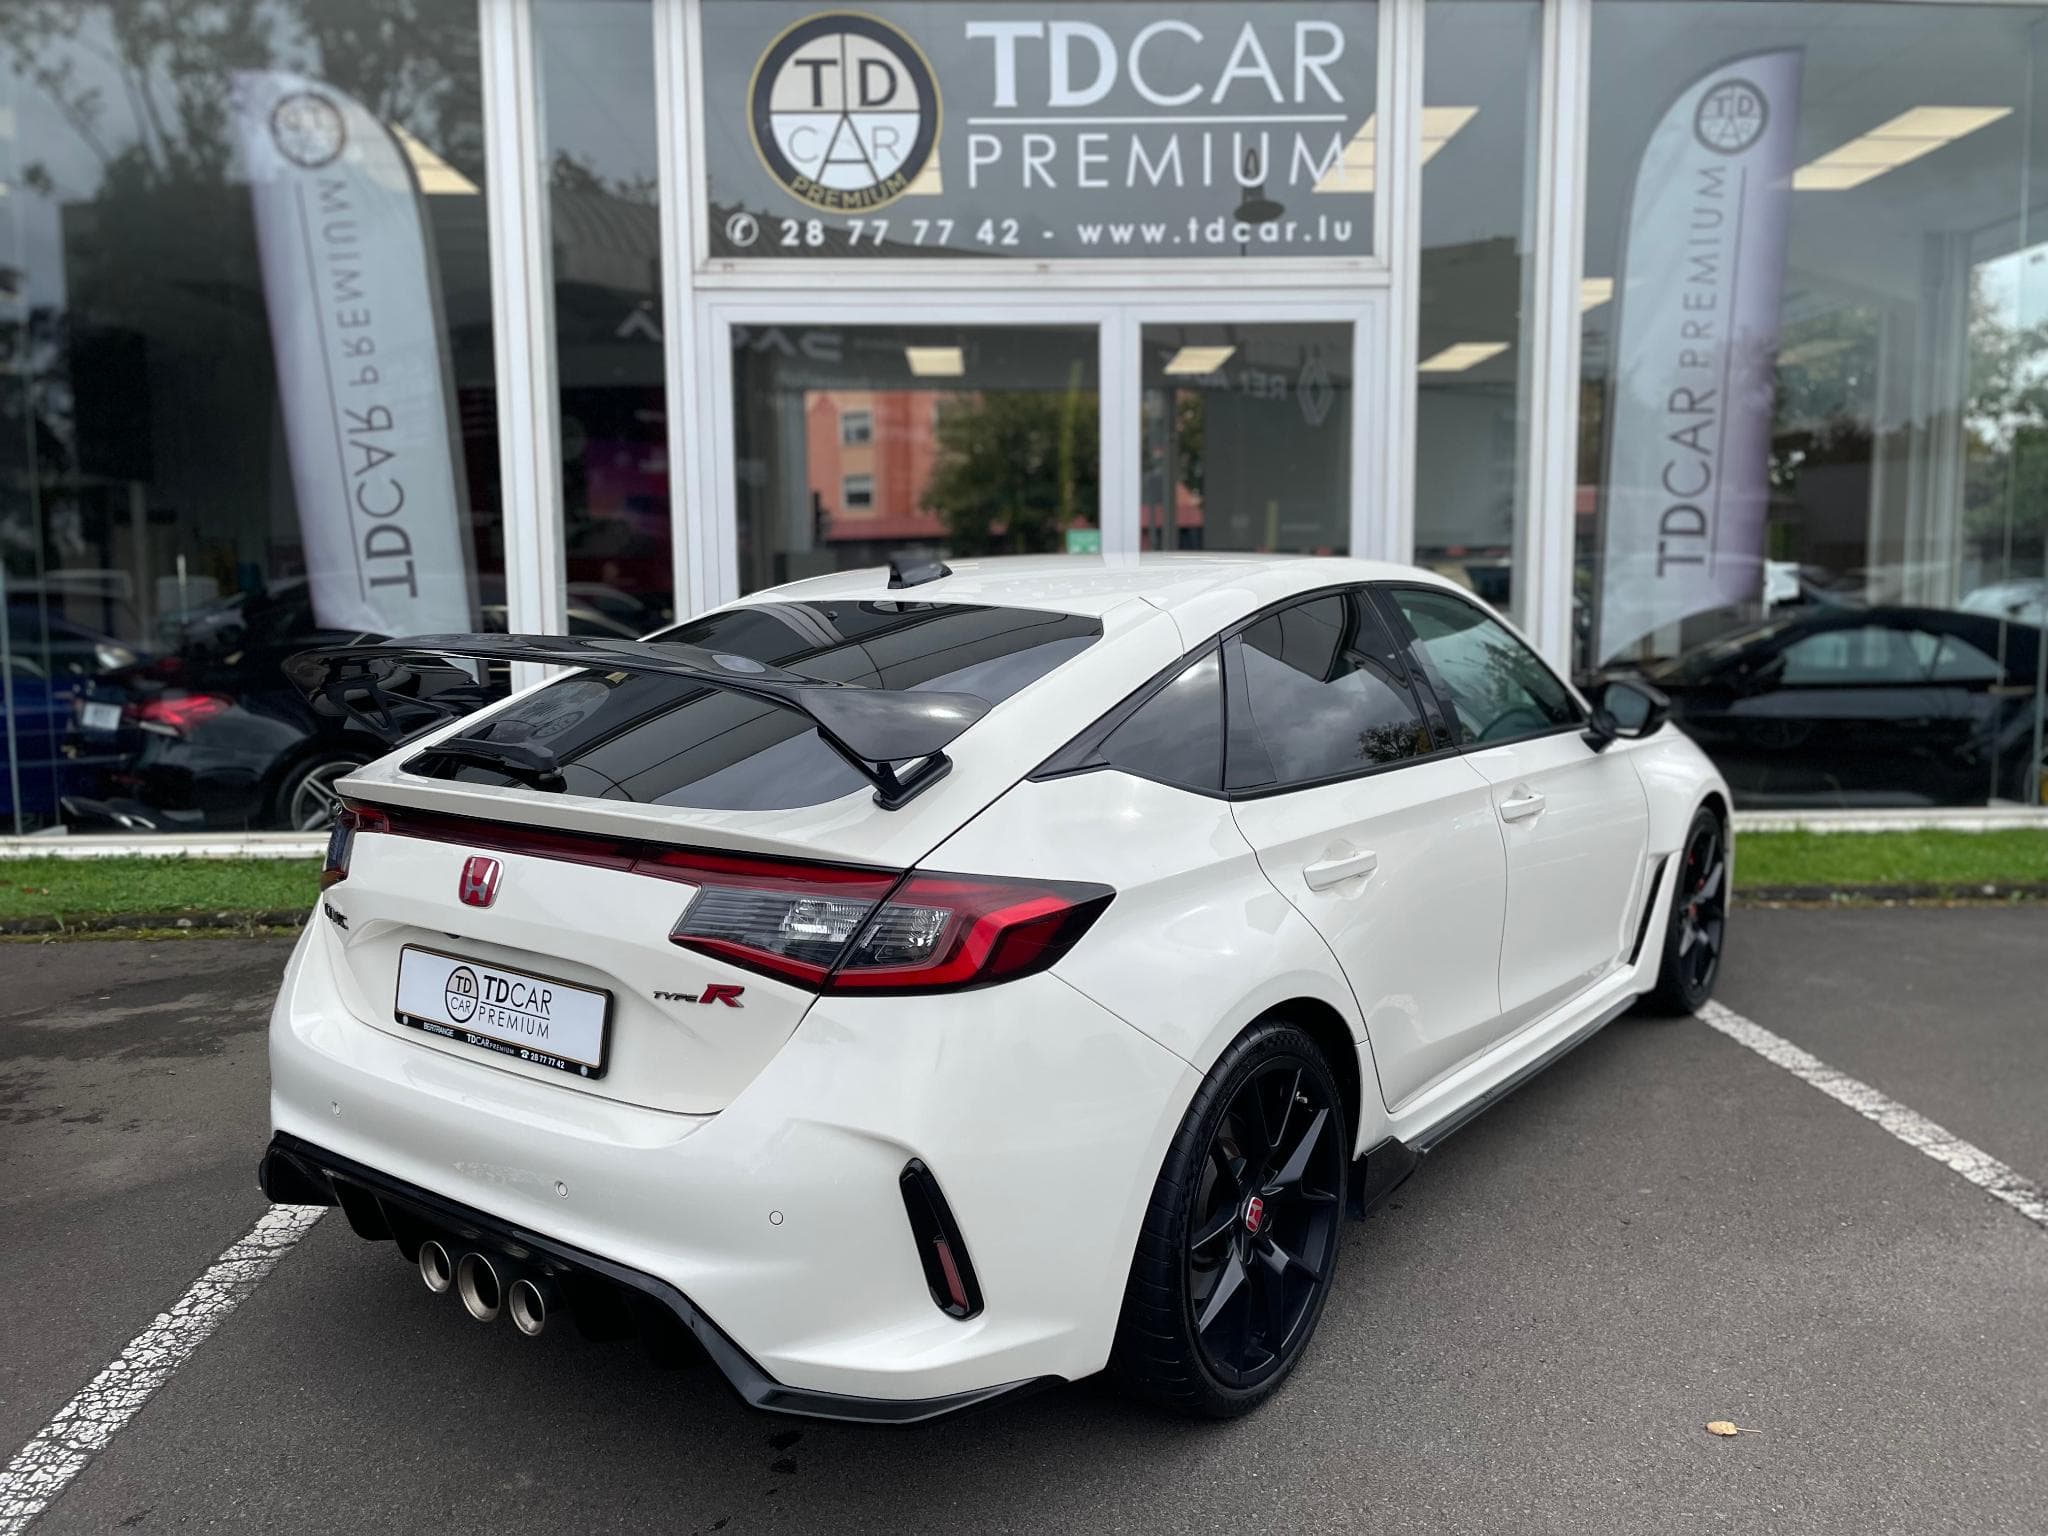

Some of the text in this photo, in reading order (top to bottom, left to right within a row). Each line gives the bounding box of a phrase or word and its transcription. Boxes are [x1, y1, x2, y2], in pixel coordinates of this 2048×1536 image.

[966, 20, 1346, 107] TDCAR
[968, 132, 1346, 188] PREMIUM
[788, 173, 908, 210] PREMIUM
[780, 219, 826, 246] 28
[846, 220, 888, 246] 77
[911, 219, 954, 246] 77
[976, 218, 1020, 245] 42
[1078, 216, 1353, 244] www.tdcar.lu
[1656, 165, 1726, 578] TDCAR PREMIUM
[455, 975, 472, 993] TD
[483, 975, 552, 1015] TDCAR
[653, 984, 745, 1008] TYPE R
[450, 996, 470, 1014] CAR
[478, 1005, 549, 1039] PREMIUM
[423, 1021, 454, 1037] BERTRANGE
